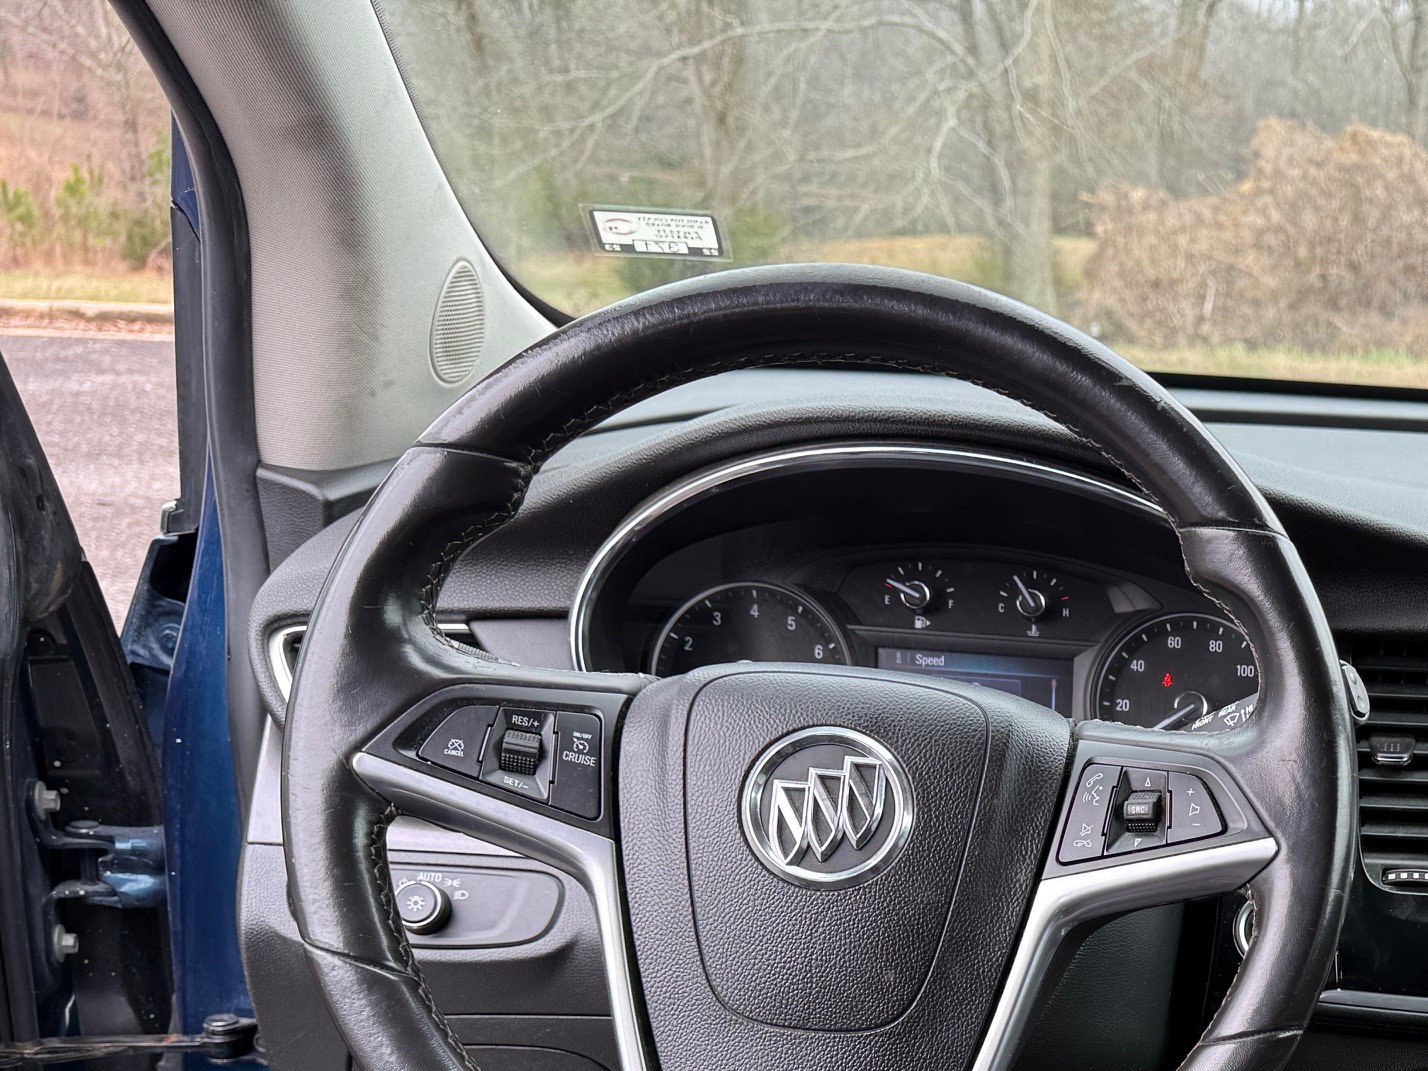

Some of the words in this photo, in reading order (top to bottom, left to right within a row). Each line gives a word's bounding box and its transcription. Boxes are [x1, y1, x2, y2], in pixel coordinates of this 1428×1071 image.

[885, 595, 891, 605] E
[948, 600, 954, 610] F
[750, 604, 759, 618] 4
[998, 603, 1005, 613] C
[1063, 608, 1070, 618] H
[712, 611, 721, 626] 3
[786, 616, 796, 631] 5
[684, 636, 693, 650] 2
[1167, 636, 1182, 649] 60
[1209, 640, 1223, 653] 80
[814, 644, 823, 659] 6
[915, 654, 945, 666] Speed
[1130, 660, 1145, 672] 40
[1236, 665, 1255, 677] 100
[1116, 699, 1130, 711] 20
[512, 714, 540, 728] RES/+
[444, 749, 464, 757] CANCEL
[562, 750, 597, 767] CRUISE
[1131, 806, 1145, 814] SRC
[417, 872, 442, 882] AUTO
